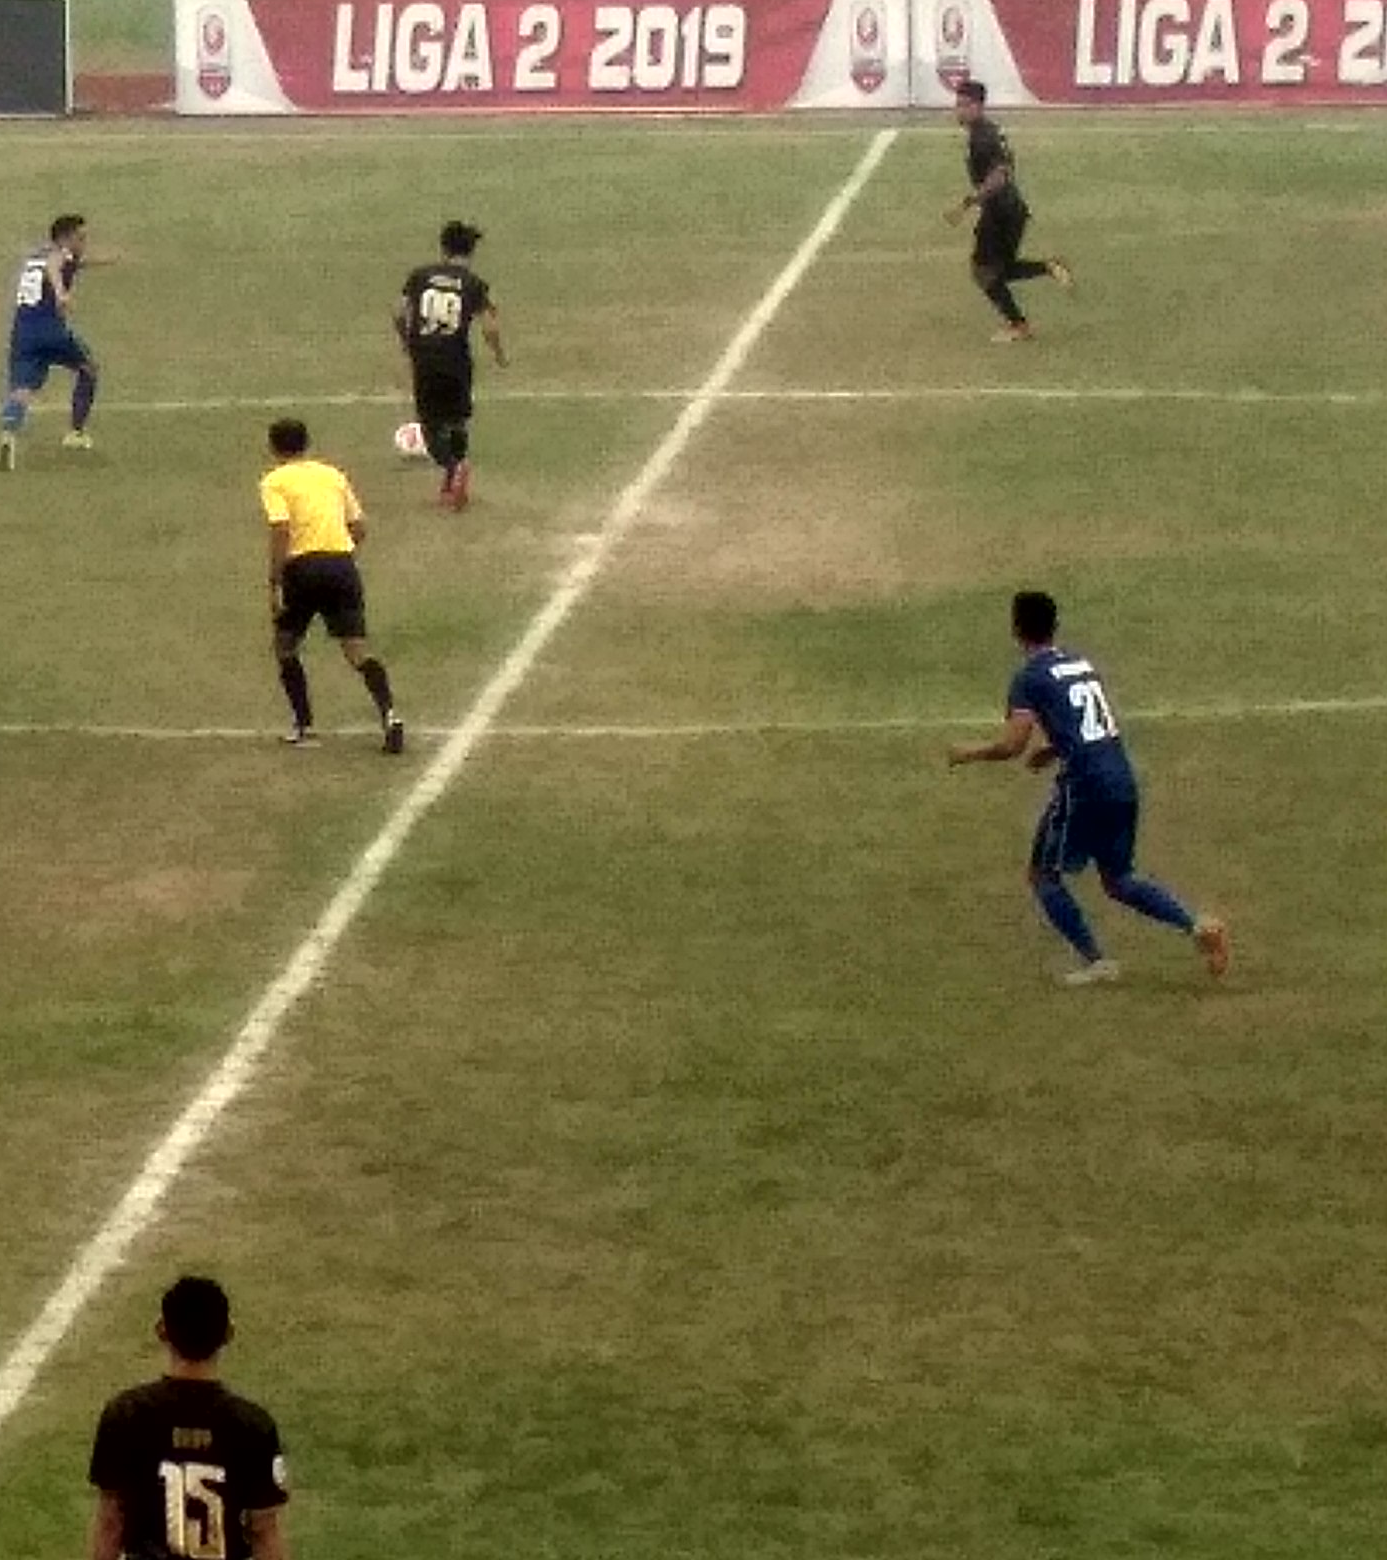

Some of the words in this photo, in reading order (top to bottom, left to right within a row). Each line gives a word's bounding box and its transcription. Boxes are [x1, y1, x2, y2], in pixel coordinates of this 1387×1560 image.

[332, 2, 494, 92] LIGA
[513, 4, 562, 90] 2
[587, 3, 747, 91] 2019
[158, 1458, 227, 1560] 15
